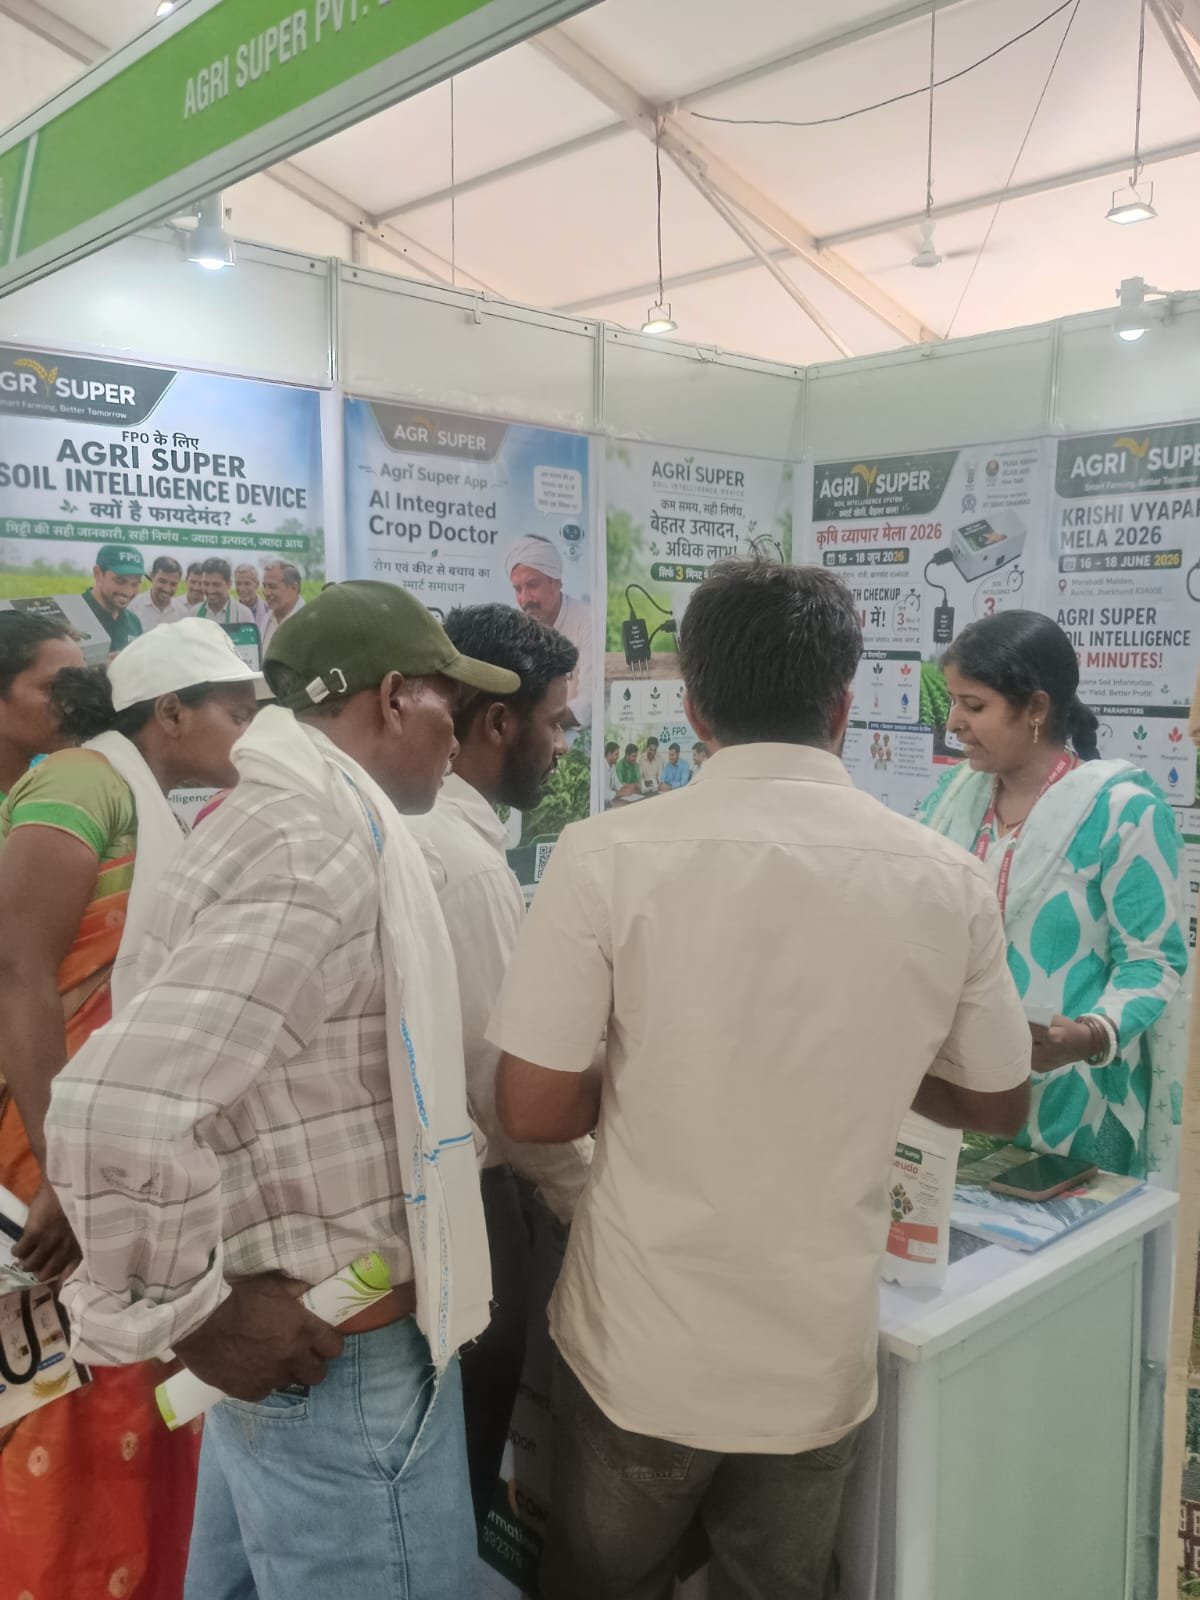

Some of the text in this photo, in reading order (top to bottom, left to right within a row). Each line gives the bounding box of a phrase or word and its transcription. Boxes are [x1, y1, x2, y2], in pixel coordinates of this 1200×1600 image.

[184, 55, 229, 118] AGRI
[235, 8, 307, 89] SUPER
[55, 376, 136, 406] SUPER
[60, 404, 85, 415] Better
[88, 407, 127, 419] Tomorrow
[122, 430, 200, 450] FPO के लिए
[437, 430, 487, 451] SUPER
[56, 438, 247, 479] AGRI SUPER
[1070, 451, 1126, 478] AGRI
[380, 463, 488, 490] Agri Super App
[652, 460, 744, 488] AGRI SUPER
[819, 469, 931, 498] AGRI SUPER
[0, 462, 307, 510] SOIL INTELLIGENCE DEVICE
[90, 498, 231, 526] क्यों है फायदेमंद?
[369, 489, 497, 520] AI Integrated
[660, 498, 676, 512] कम
[678, 500, 702, 515] समय,
[703, 502, 718, 516] सही
[1062, 503, 1124, 526] KRISHI
[34, 522, 50, 535] की
[53, 524, 74, 538] सही
[77, 526, 126, 541] जानकारी,
[129, 528, 150, 543] सही
[152, 528, 180, 544] निर्णय
[369, 514, 499, 545] Crop Doctor
[650, 509, 739, 542] बेहतर उत्पादन,
[816, 524, 838, 550] कृषि
[841, 527, 880, 544] व्यापार
[881, 522, 907, 542] मेला
[910, 523, 942, 541] 2026
[665, 536, 704, 558] अधिक
[1060, 525, 1162, 550] MELA 2026
[119, 551, 141, 564] FPO
[373, 557, 392, 572] रोग
[395, 560, 409, 573] एवं
[412, 560, 433, 575] कीट
[436, 562, 446, 576] से
[477, 568, 491, 578] का
[838, 553, 847, 564] 16
[856, 552, 865, 563] 18
[866, 552, 881, 565] जून
[882, 551, 904, 563] 2026
[1079, 557, 1091, 569] 16
[1105, 556, 1118, 567] 18
[1120, 554, 1151, 567] JUNE
[1153, 553, 1180, 567] 2026
[675, 565, 684, 581] 3
[428, 580, 465, 593] समाधान
[864, 588, 901, 601] CHECKUP
[870, 605, 885, 627] में!
[984, 597, 995, 617] 3
[1057, 607, 1157, 625] AGRI SUPER
[897, 612, 904, 625] 3
[1089, 629, 1191, 647] INTELLIGENCE
[1087, 652, 1163, 668] MINUTES!
[1103, 706, 1144, 715] PARAMETERS
[672, 726, 687, 736] FPO
[894, 1159, 919, 1175] eudo
